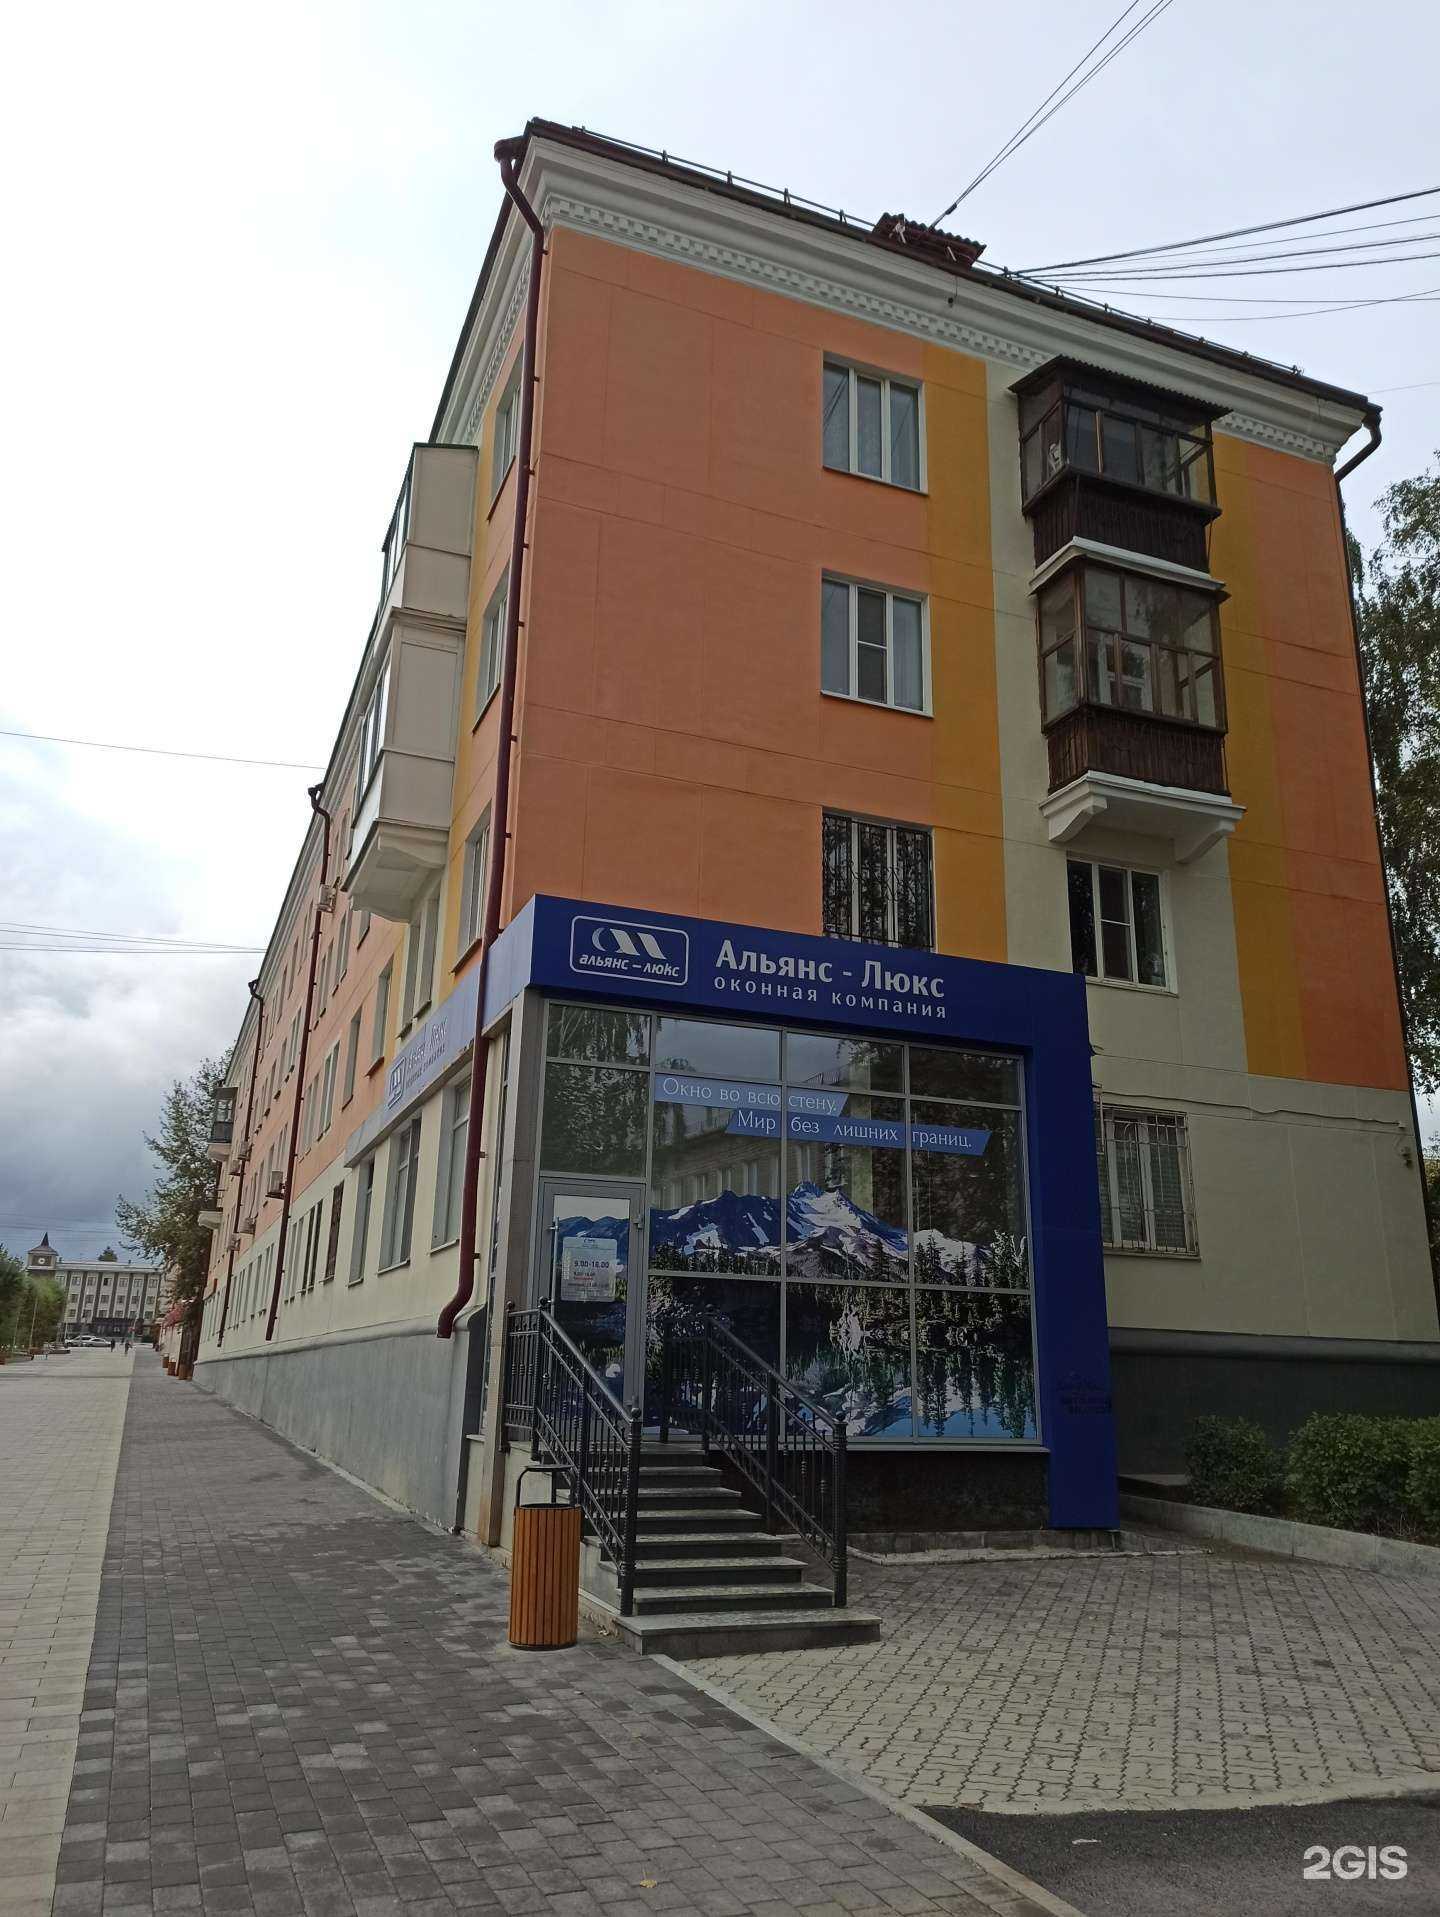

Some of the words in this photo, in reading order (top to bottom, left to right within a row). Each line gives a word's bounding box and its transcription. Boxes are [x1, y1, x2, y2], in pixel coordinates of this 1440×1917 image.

[580, 954, 629, 970] альянс
[643, 962, 680, 977] люкс
[715, 939, 833, 983] Альянс
[862, 960, 945, 998] Люкс
[714, 976, 817, 1002] оконная
[832, 992, 946, 1019] компания
[663, 1078, 712, 1099] Окно
[720, 1089, 740, 1101] во
[748, 1091, 780, 1105] всю
[788, 1095, 837, 1115] стену.
[738, 1110, 776, 1134] Мир
[791, 1117, 820, 1134] без
[833, 1124, 899, 1141] лишних
[912, 1130, 972, 1148] границ.
